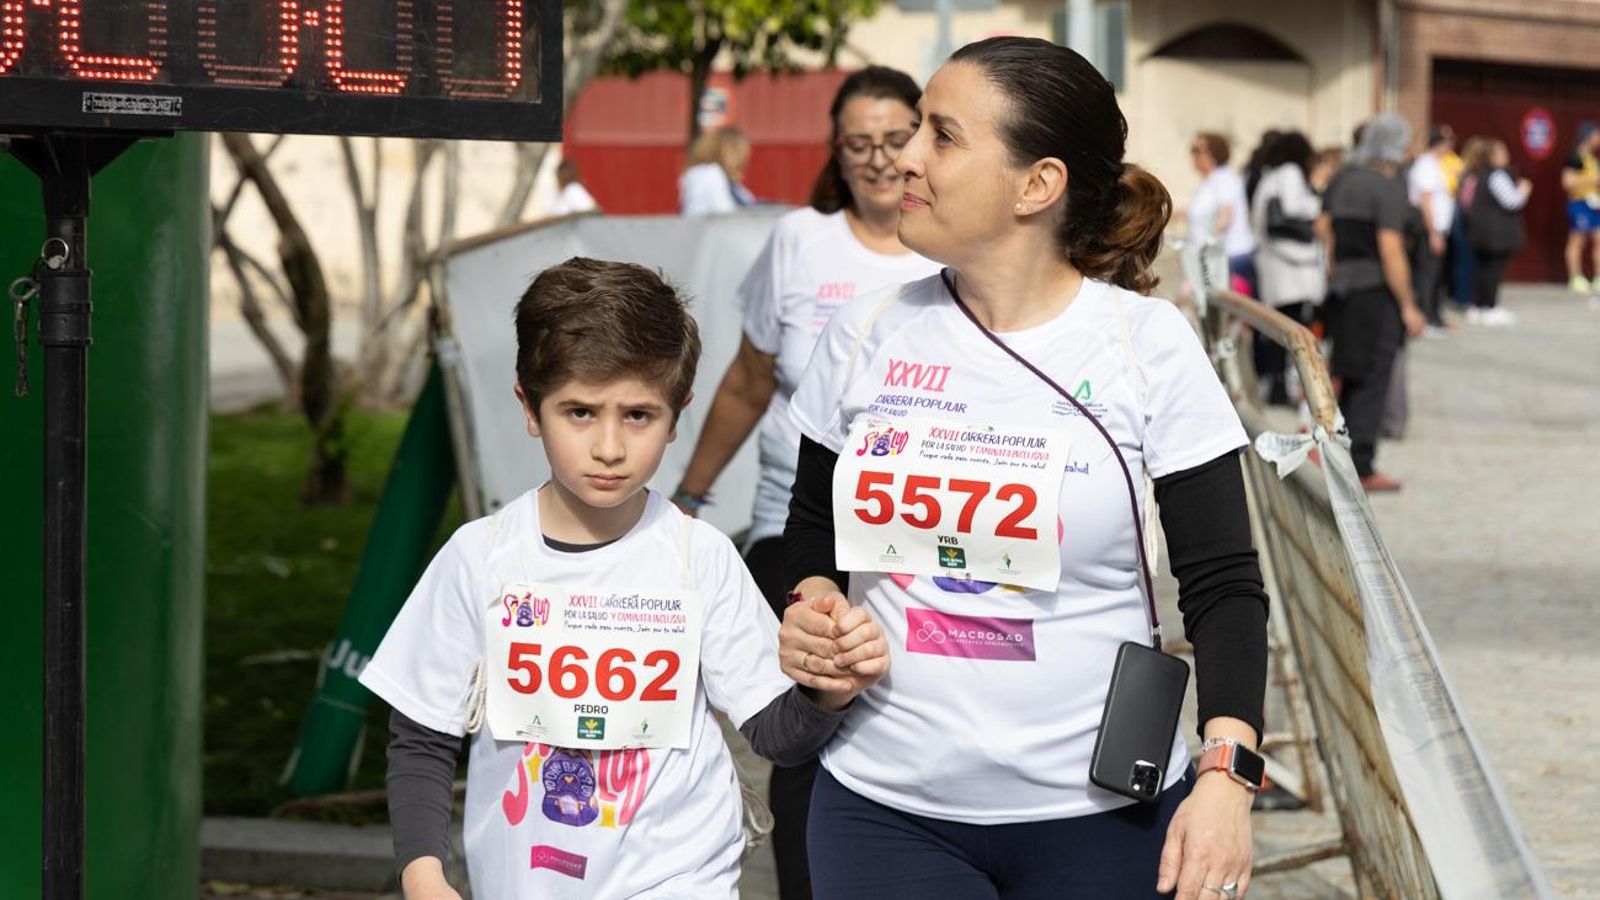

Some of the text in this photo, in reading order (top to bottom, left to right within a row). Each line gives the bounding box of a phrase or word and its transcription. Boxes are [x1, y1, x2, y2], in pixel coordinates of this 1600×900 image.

[884, 358, 951, 393] XXVII
[875, 394, 967, 414] CARRERA POPULAR
[929, 427, 1047, 449] XXVII CARRERA POPULAR
[921, 440, 936, 449] POR
[936, 442, 945, 450] LA
[945, 443, 967, 452] SALUD
[975, 446, 1011, 457] CAMINATA
[1011, 450, 1049, 460] INCLUSIVA
[854, 470, 1038, 540] 5572
[937, 535, 959, 546] YRB
[569, 595, 682, 611] XXVII CARRERA POPULAR
[565, 610, 578, 620] POR
[578, 611, 587, 620] LA
[587, 611, 608, 621] SALUD
[617, 613, 652, 623] CAMINATA
[652, 614, 687, 625] INCLUSIVA
[948, 629, 1024, 643] MACROSAD
[507, 642, 680, 701] 5662
[573, 703, 609, 715] PEDRO
